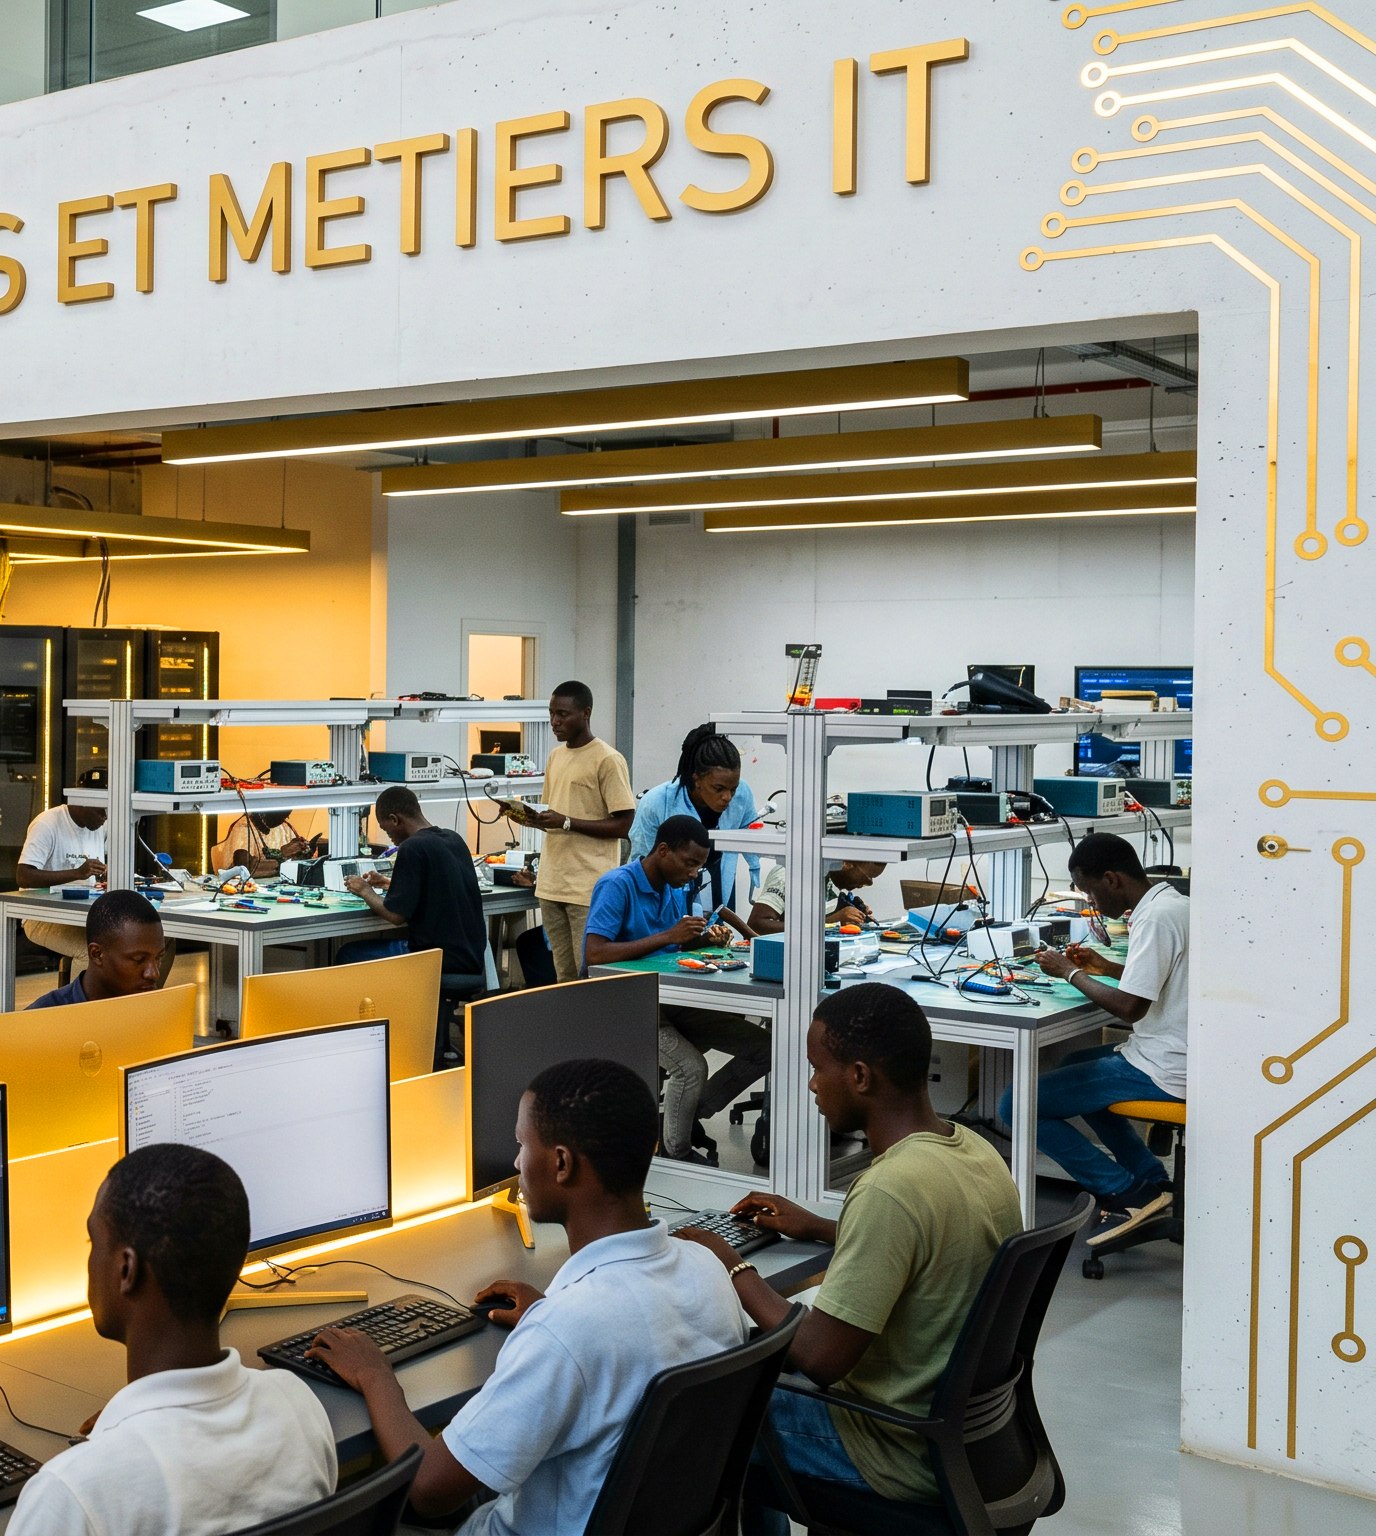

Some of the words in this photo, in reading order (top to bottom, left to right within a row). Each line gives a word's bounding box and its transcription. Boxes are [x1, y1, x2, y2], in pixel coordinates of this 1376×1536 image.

[57, 182, 178, 305] ET
[208, 78, 775, 284] METIERS
[832, 37, 971, 197] IT
